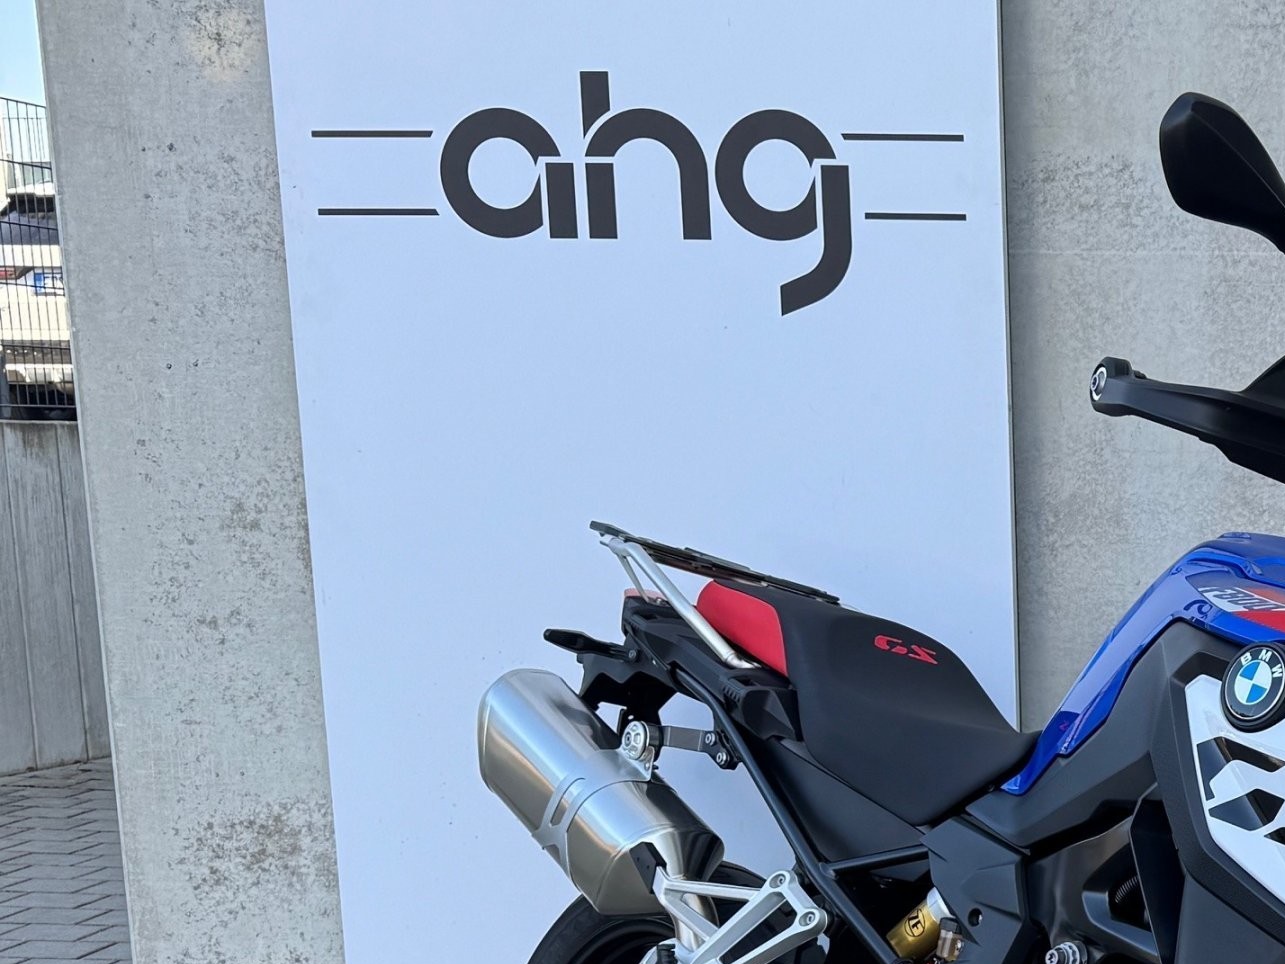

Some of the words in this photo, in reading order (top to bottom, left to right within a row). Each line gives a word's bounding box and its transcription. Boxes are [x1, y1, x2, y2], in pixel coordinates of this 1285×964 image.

[440, 71, 853, 316] ahg
[873, 634, 939, 665] GS
[1239, 648, 1284, 679] BMW
